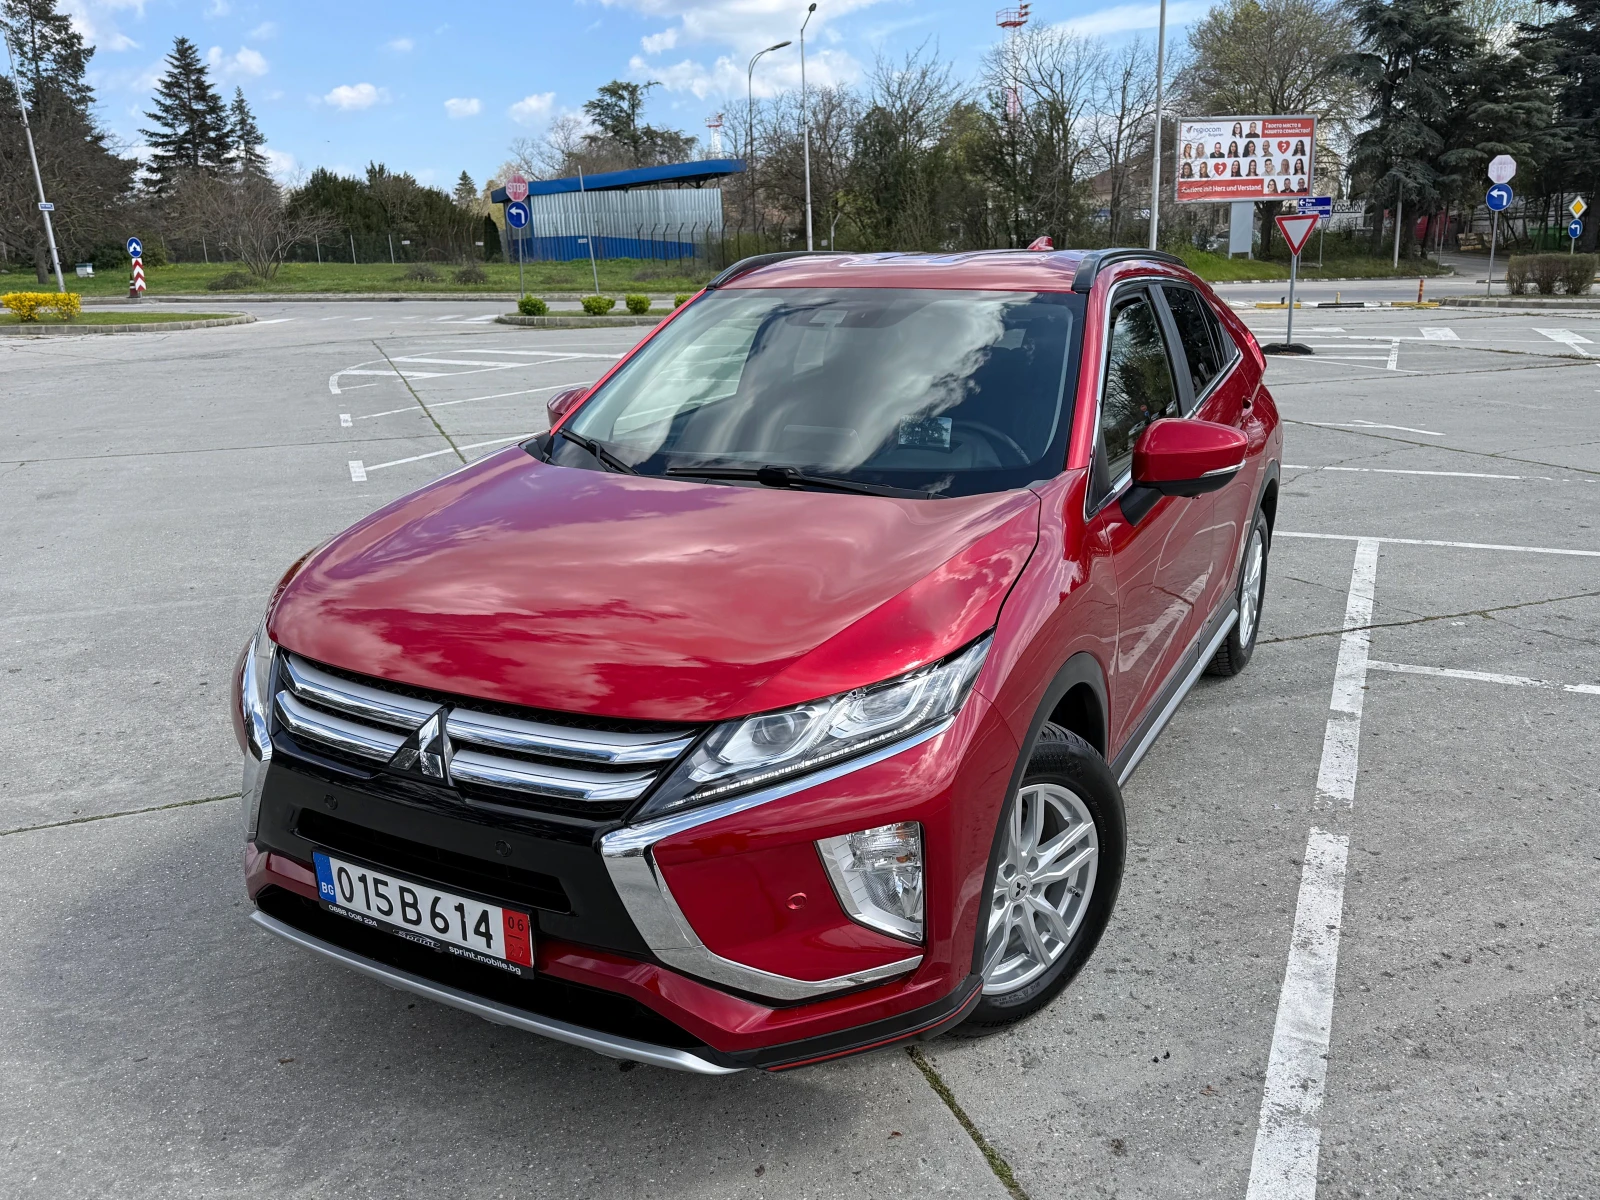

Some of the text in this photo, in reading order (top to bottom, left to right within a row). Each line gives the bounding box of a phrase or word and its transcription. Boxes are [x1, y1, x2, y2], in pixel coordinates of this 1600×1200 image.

[1491, 164, 1513, 175] STOP
[507, 182, 526, 193] STOP
[321, 881, 334, 896] BG
[337, 866, 493, 949] 015B614
[508, 916, 524, 932] 06
[448, 946, 522, 976] sprint.mobile.bg
